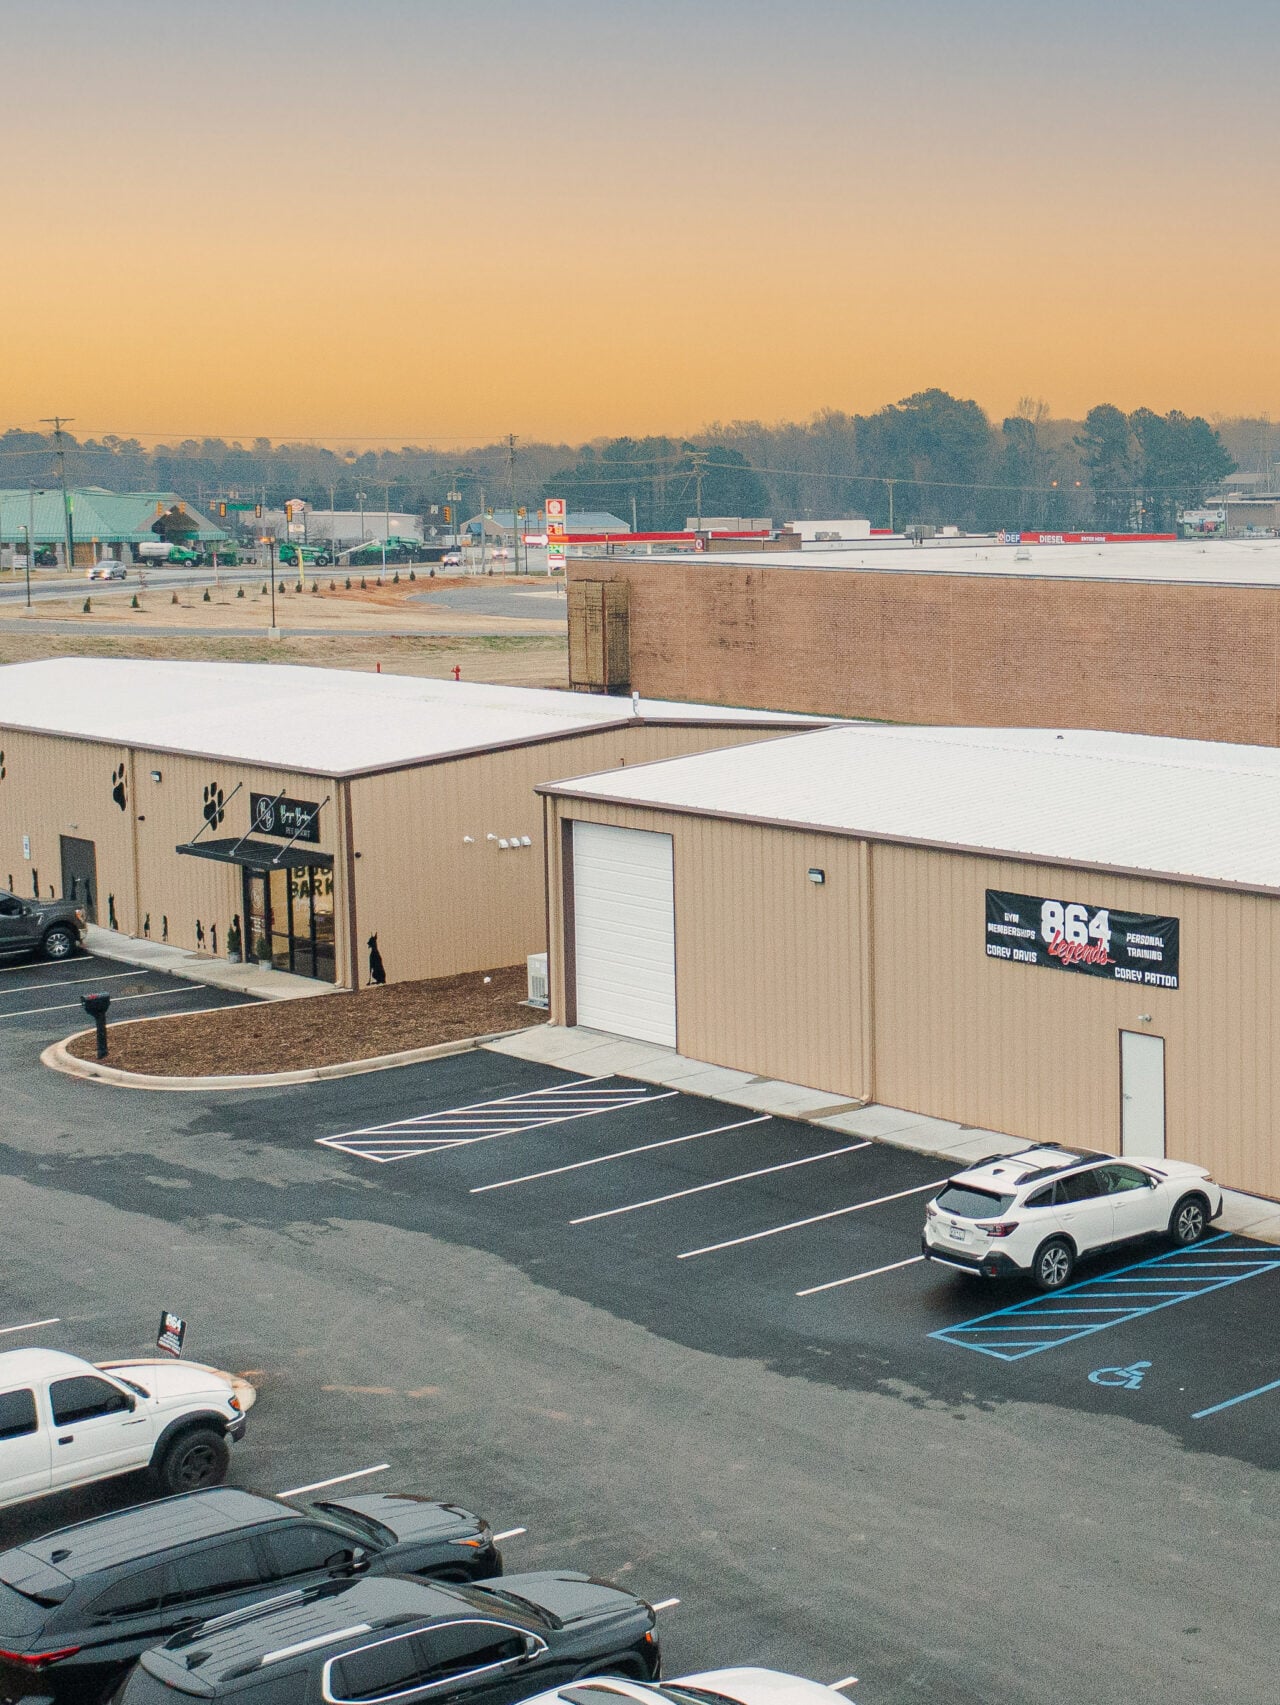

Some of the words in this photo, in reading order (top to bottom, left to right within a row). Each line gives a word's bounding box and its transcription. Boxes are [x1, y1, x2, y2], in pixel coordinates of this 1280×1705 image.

[1005, 534, 1020, 543] DEF
[1039, 535, 1065, 543] DIESEL
[1004, 912, 1019, 923] GYM
[987, 922, 1036, 940] MEMBERSHIPS
[1041, 900, 1112, 953] 864
[1047, 929, 1117, 966] Legends
[1126, 932, 1165, 948] PERSONAL
[987, 943, 1011, 958] COREY
[1013, 948, 1037, 963] DAVIS
[1126, 946, 1162, 961] TRAINING
[1114, 966, 1142, 981] COREY
[1144, 971, 1177, 987] PATTON
